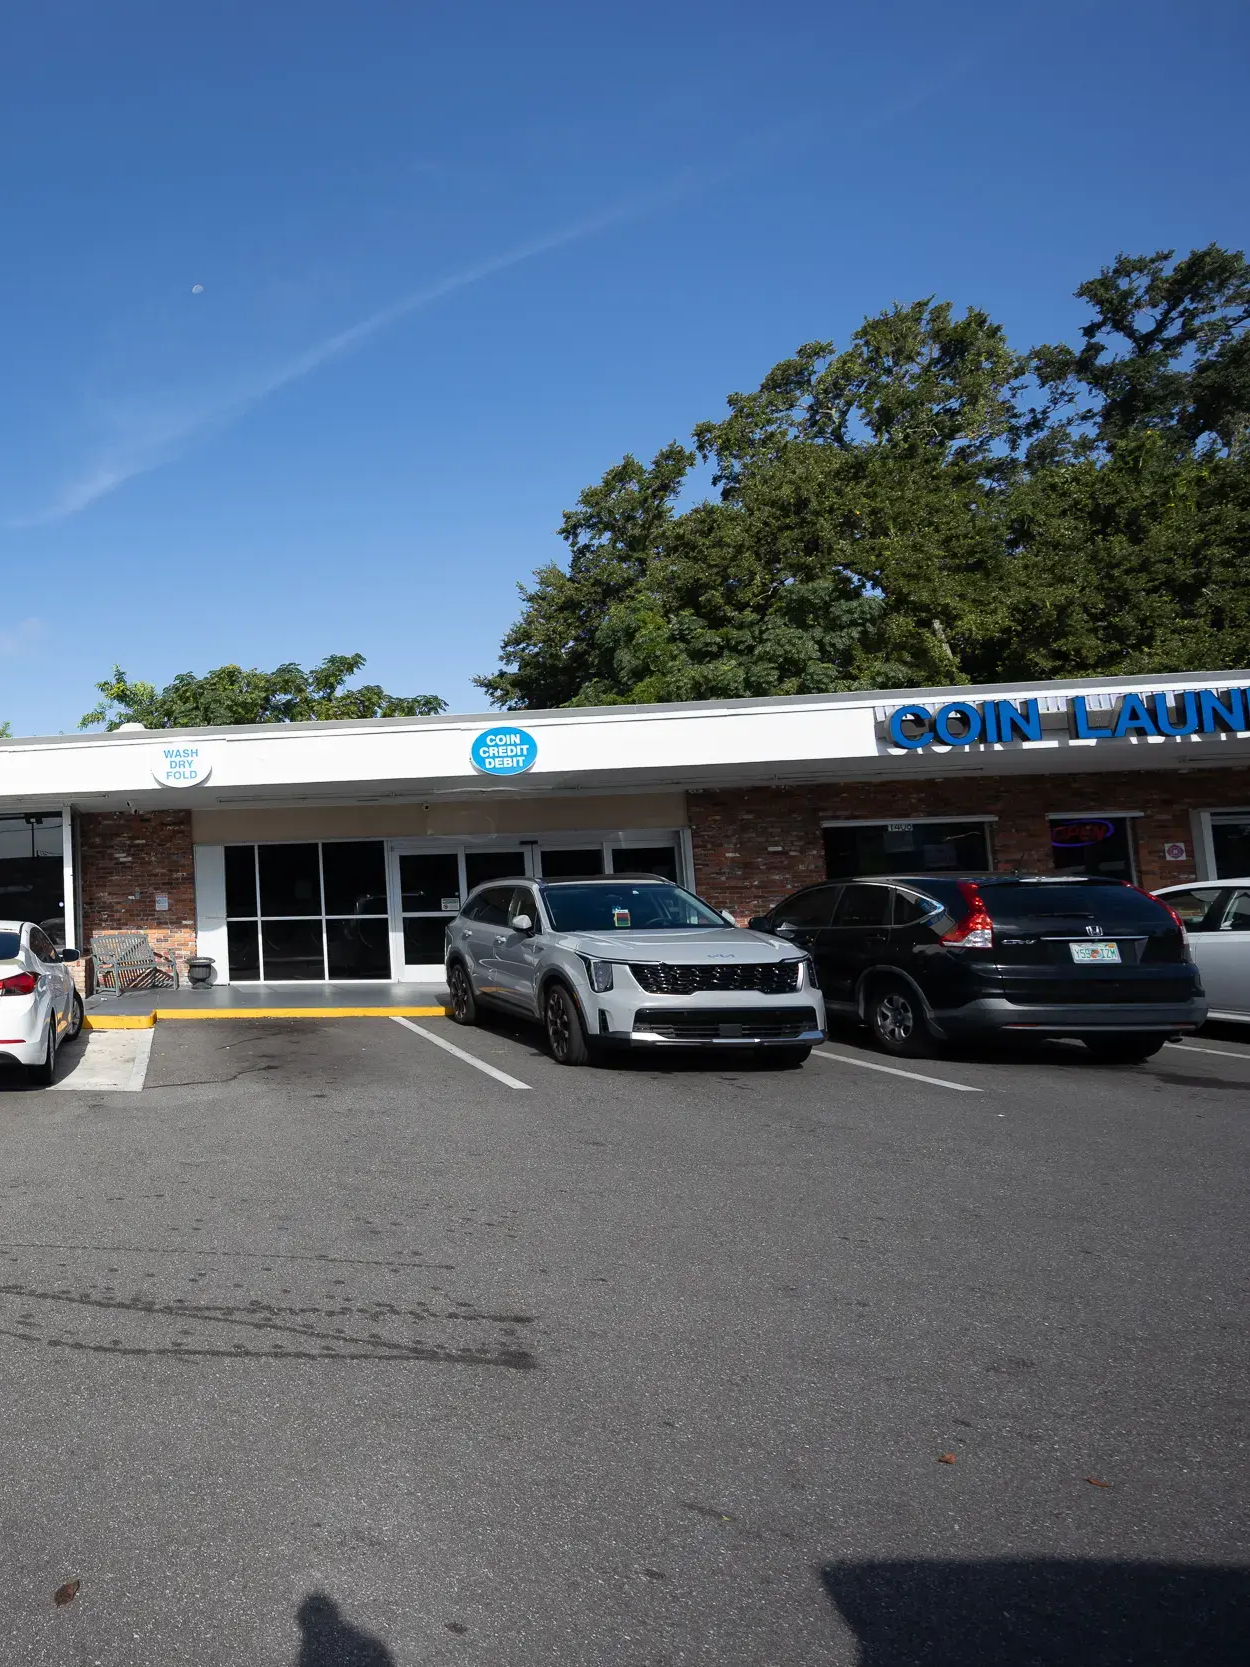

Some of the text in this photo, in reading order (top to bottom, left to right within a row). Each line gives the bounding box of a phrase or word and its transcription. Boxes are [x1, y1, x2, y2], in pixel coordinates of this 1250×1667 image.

[888, 687, 1250, 749] COIN LAUN
[486, 734, 521, 745] COIN
[163, 749, 198, 758] WASH
[479, 745, 529, 757] CREDIT
[170, 760, 193, 769] DRY
[485, 757, 525, 768] DEBIT
[166, 770, 197, 780] FOLD
[1053, 824, 1107, 842] OPEN
